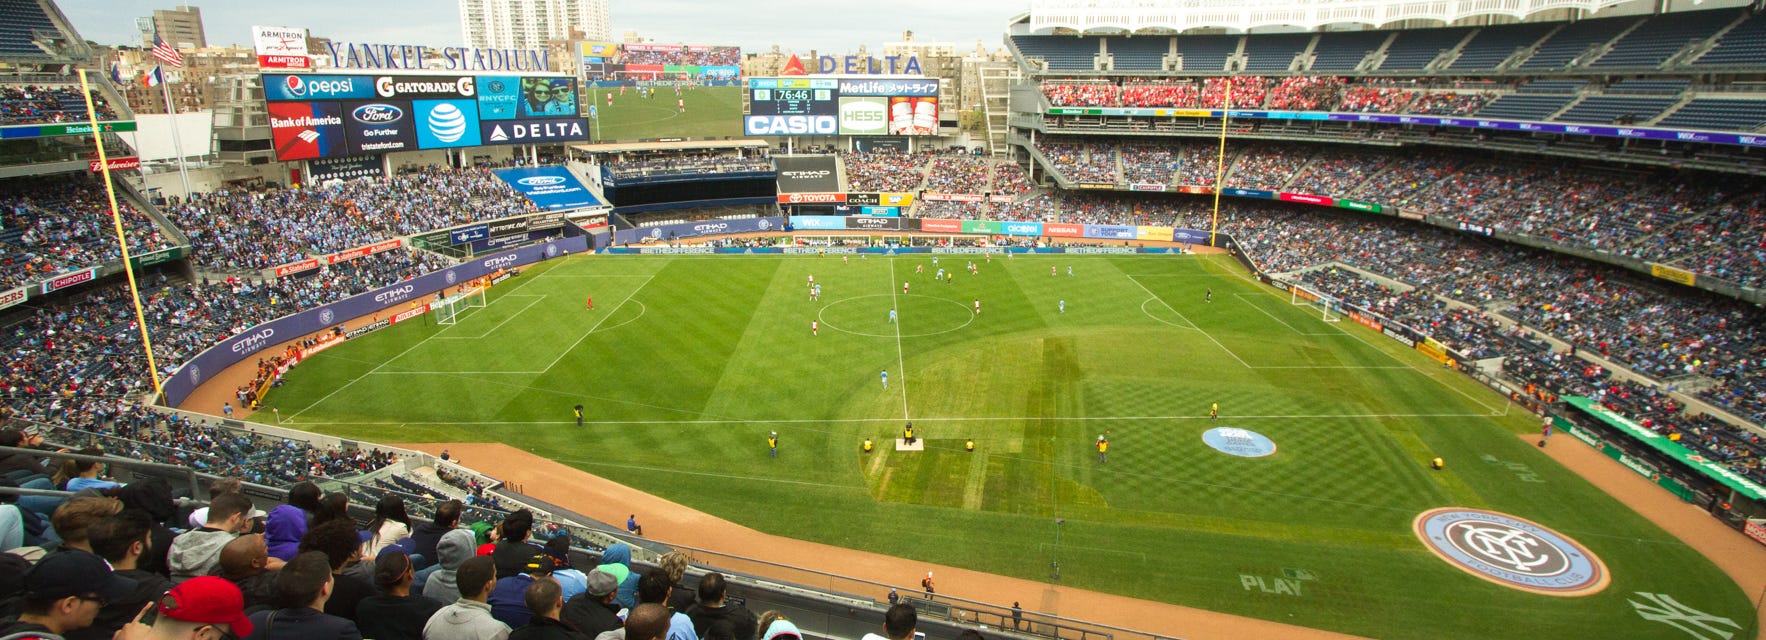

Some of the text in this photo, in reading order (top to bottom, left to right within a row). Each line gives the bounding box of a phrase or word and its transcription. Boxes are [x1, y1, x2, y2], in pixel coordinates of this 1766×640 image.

[261, 31, 302, 39] ARMITRON
[326, 42, 549, 72] YANKEE STADIUM
[819, 56, 922, 74] DELTA
[310, 78, 353, 96] pepsi
[396, 82, 456, 93] GATORADE
[840, 82, 884, 93] MetLife
[888, 84, 938, 92] メットライフ
[779, 90, 808, 100] 76:46
[362, 106, 393, 121] Ford
[844, 111, 883, 121] HESS
[271, 116, 341, 128] Bank of America
[748, 116, 836, 134] CASIO
[513, 122, 582, 138] DELTA
[90, 160, 140, 172] Bdweiser
[694, 222, 728, 231] ETIHAD
[484, 254, 518, 267] ETIHAD
[54, 270, 91, 288] CHIPOTLE
[374, 284, 414, 302] ETIHAD
[384, 294, 408, 304] AIRWAYS
[232, 328, 274, 352] ETIHAD
[241, 340, 266, 355] AIRWAYS
[1465, 513, 1500, 524] YORK
[1506, 519, 1541, 533] CITY
[1468, 559, 1584, 585] FOOTBALL CLUB
[1240, 574, 1302, 596] PLAY
